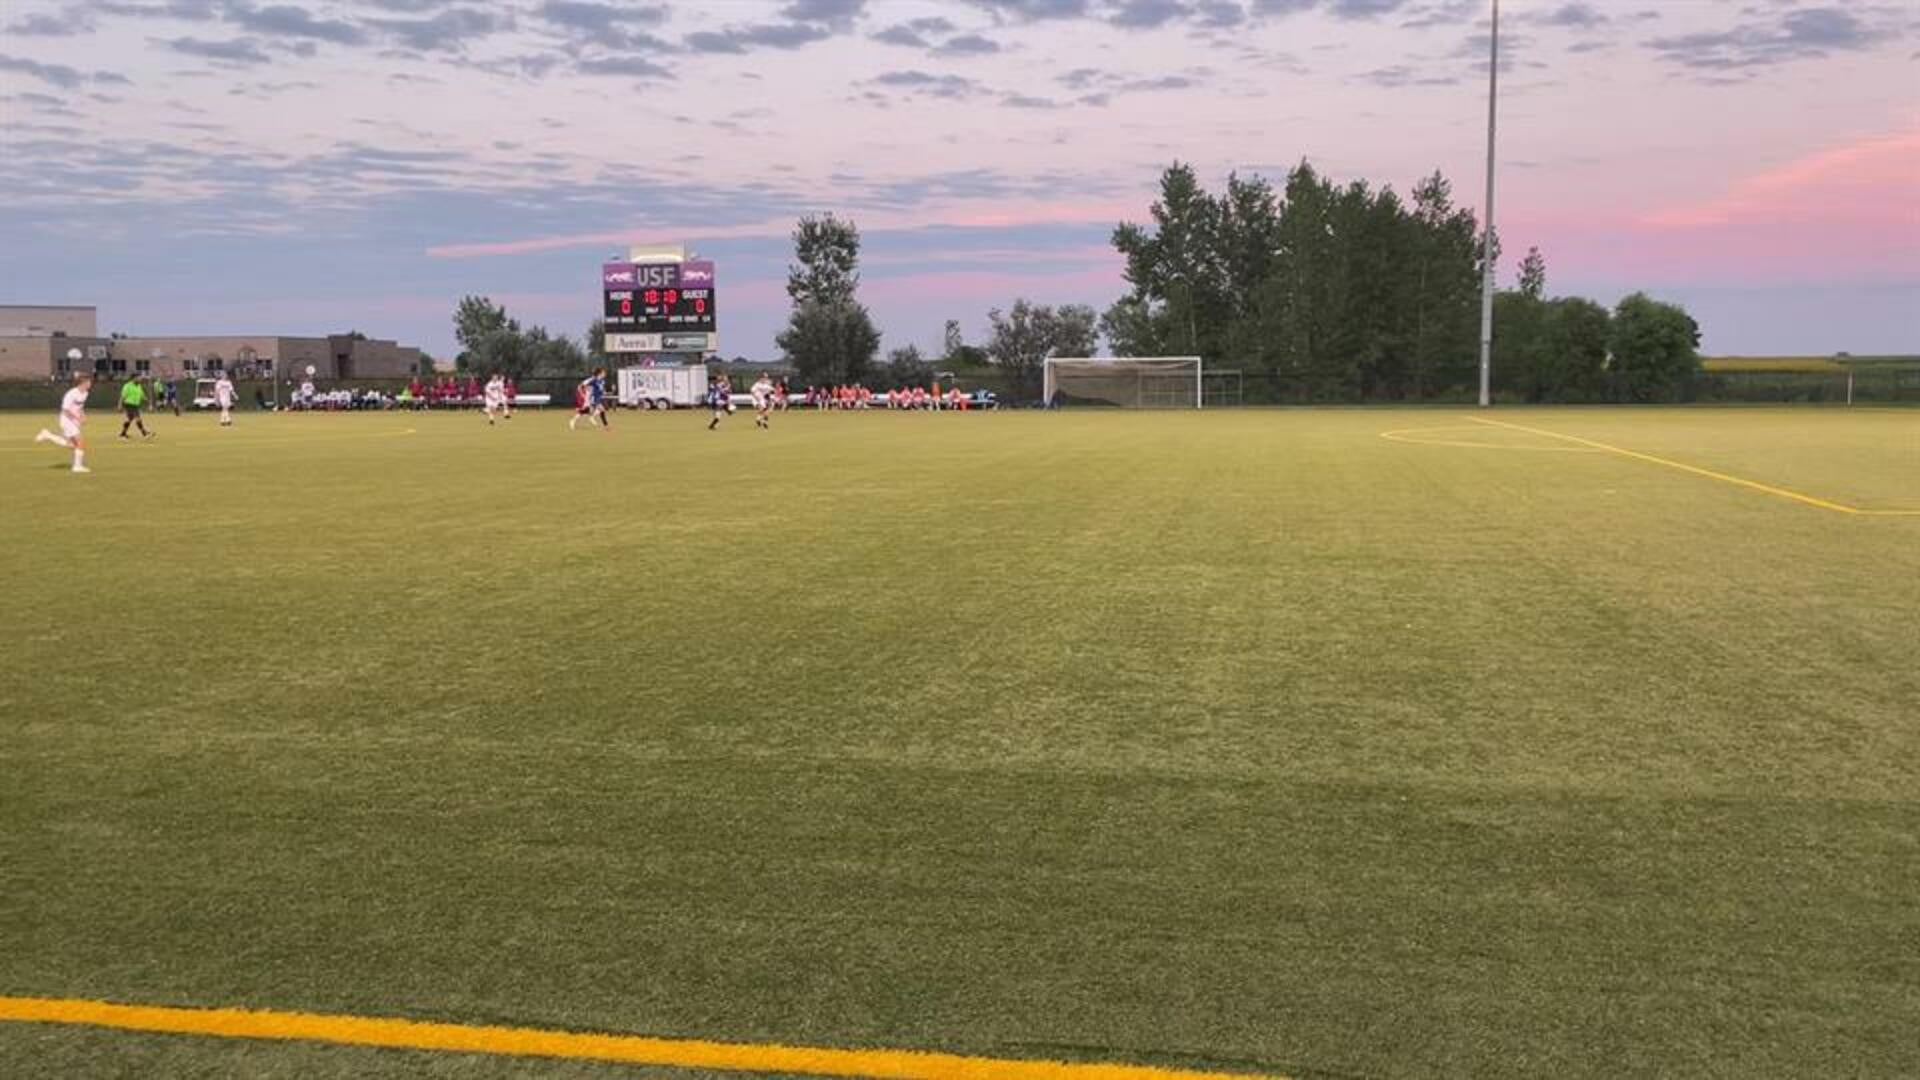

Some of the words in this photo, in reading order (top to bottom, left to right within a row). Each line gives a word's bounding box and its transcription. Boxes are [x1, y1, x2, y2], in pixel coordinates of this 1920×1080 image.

[637, 267, 675, 287] USF
[682, 290, 708, 299] GUEST
[621, 299, 631, 314] 0
[695, 299, 705, 313] 0
